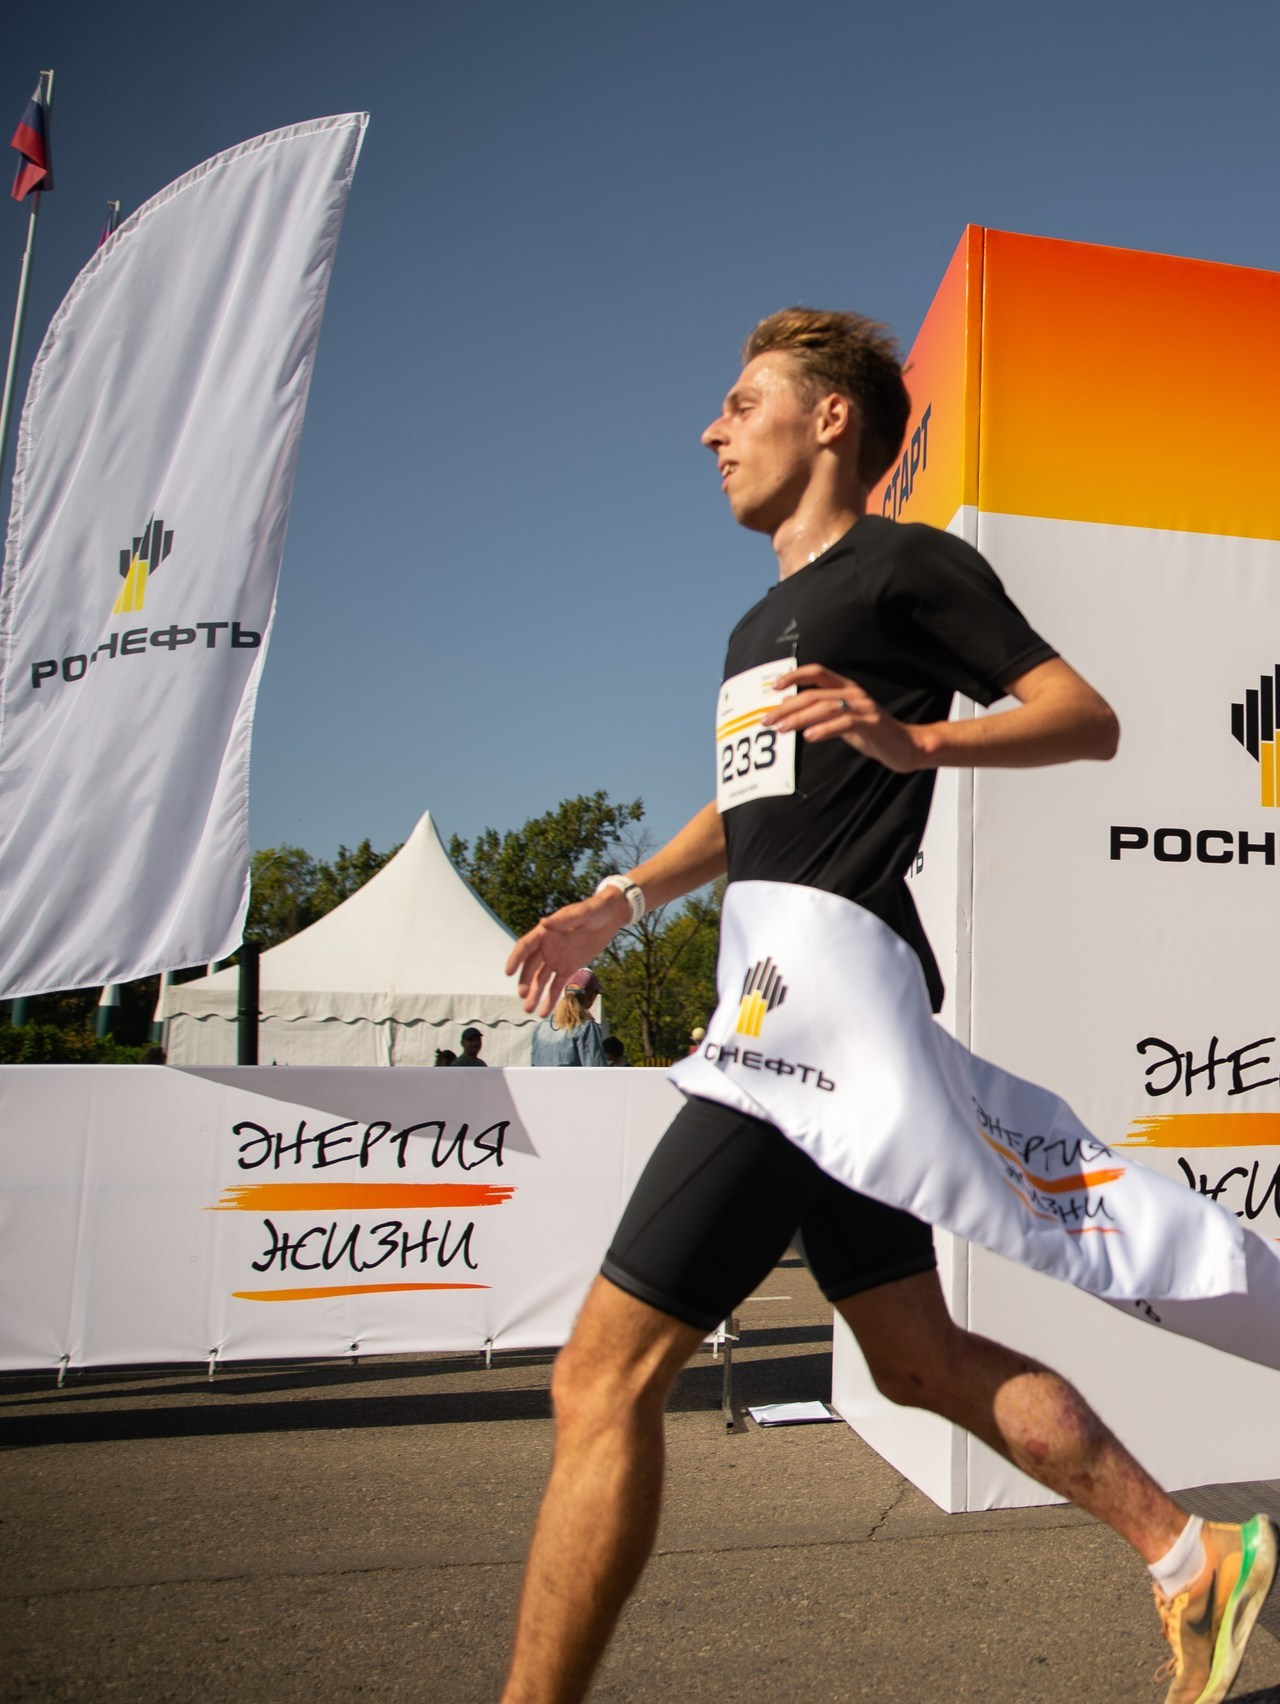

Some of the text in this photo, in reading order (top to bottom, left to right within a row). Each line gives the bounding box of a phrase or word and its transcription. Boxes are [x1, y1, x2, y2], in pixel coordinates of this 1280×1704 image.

[31, 621, 262, 689] РОНЕФТЬ
[722, 730, 777, 784] 233
[704, 1043, 836, 1092] СНЕФТЬ
[232, 1120, 511, 1170] ЭНЕРГИЯ
[251, 1218, 479, 1273] ЖИЗНИ
